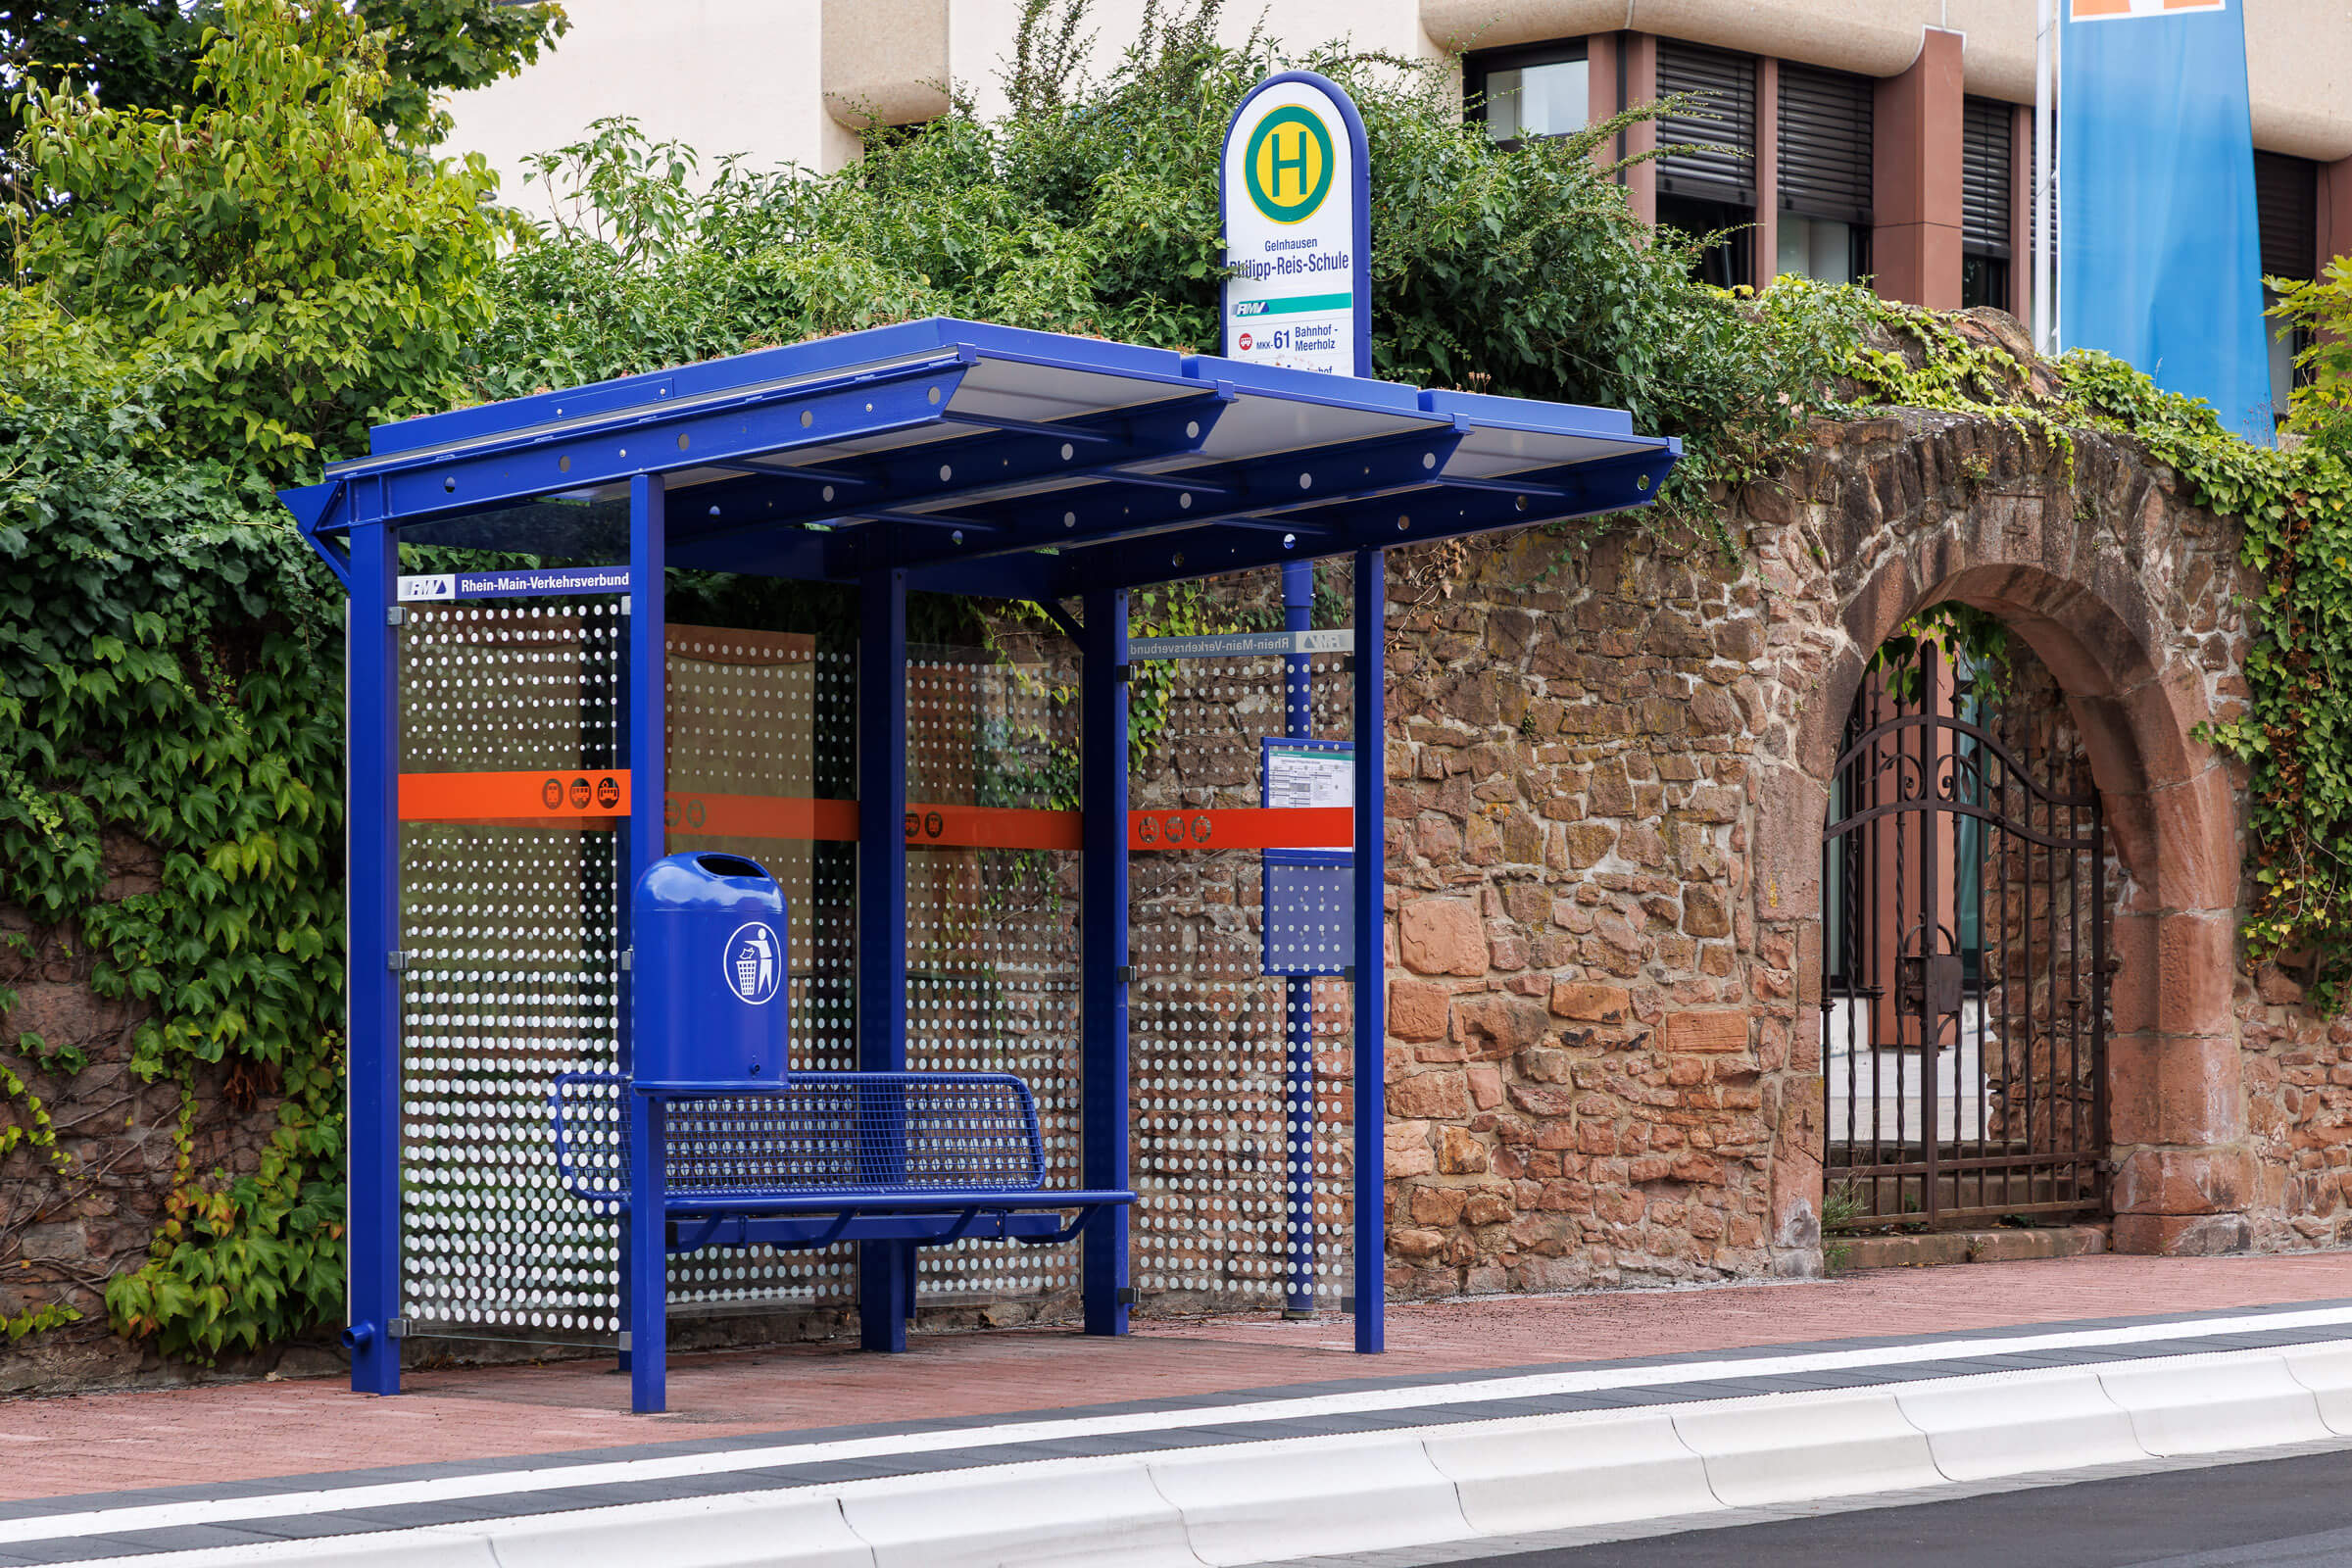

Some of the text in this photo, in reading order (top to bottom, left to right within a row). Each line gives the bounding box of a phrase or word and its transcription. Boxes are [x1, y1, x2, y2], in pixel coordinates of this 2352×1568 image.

[1271, 131, 1307, 198] H
[1264, 238, 1318, 252] Gelnhausen
[1236, 302, 1267, 315] RMV
[1295, 323, 1332, 338] Bahnhof
[1295, 338, 1336, 352] Meerholz
[461, 571, 630, 593] Rhein-Main-Verkehrsverbund
